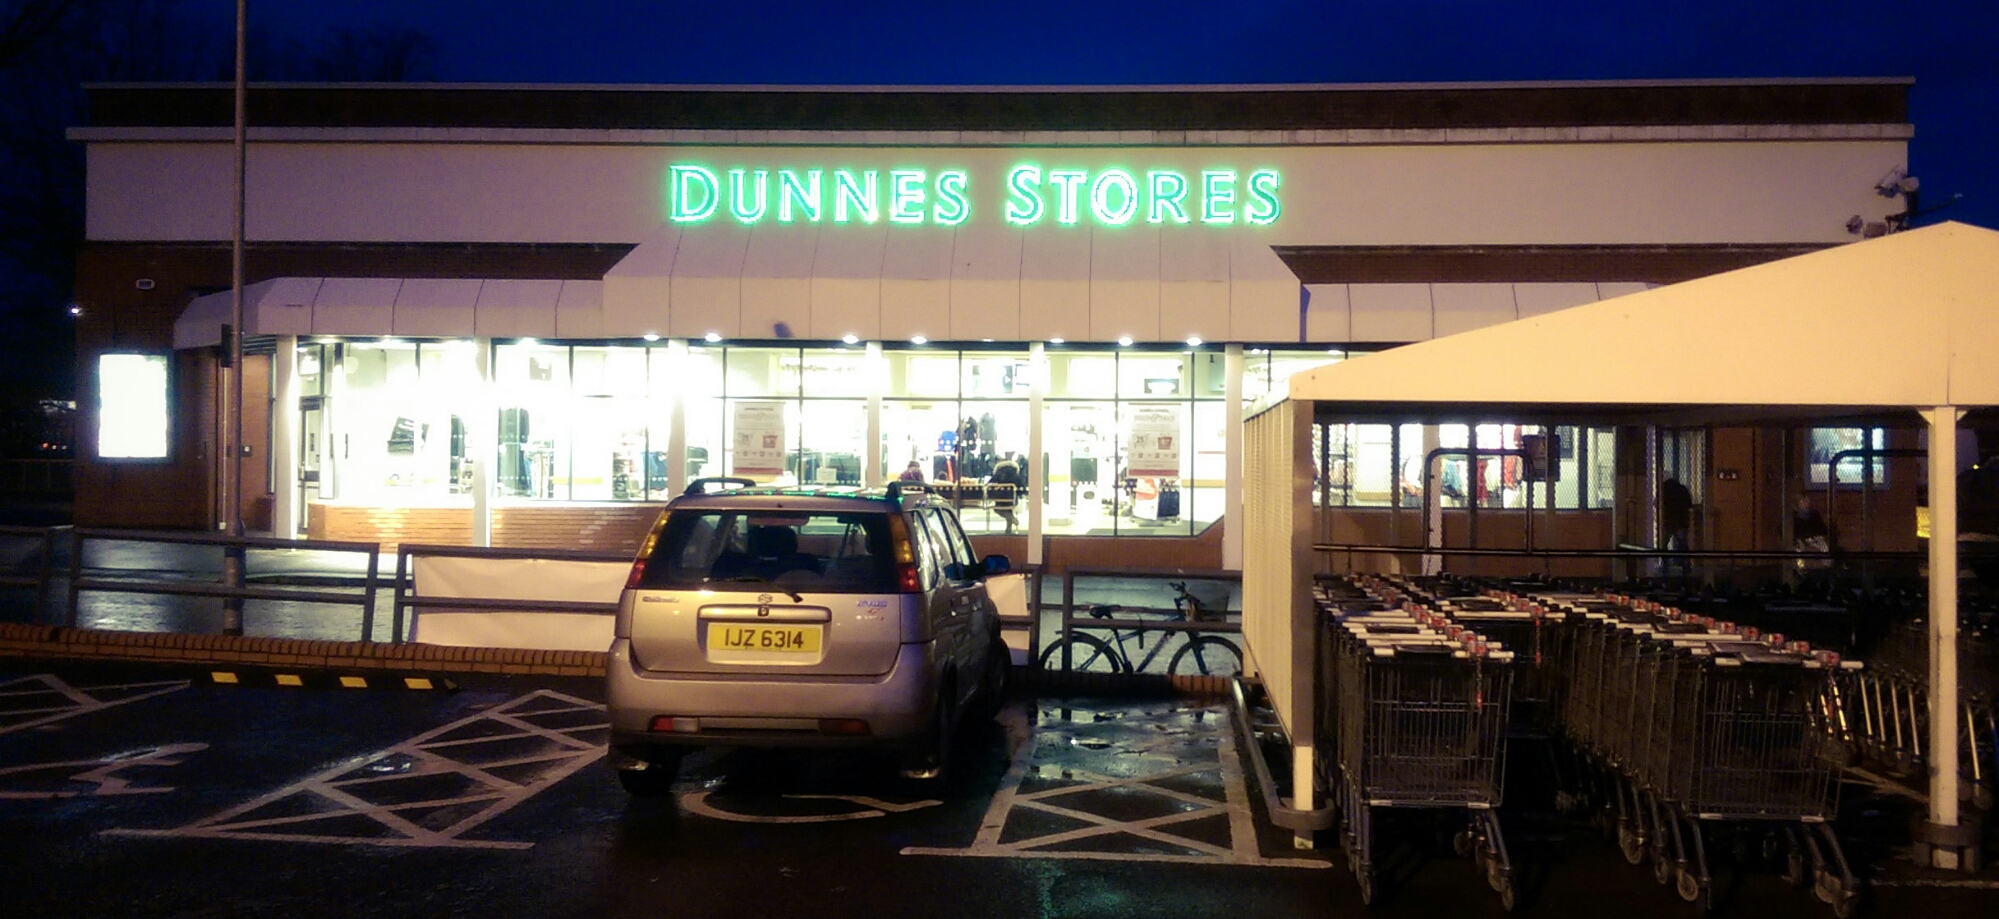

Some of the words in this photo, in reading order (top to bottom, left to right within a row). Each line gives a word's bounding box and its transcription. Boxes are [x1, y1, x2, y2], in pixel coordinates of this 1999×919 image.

[670, 165, 971, 224] DUNNES
[1006, 165, 1281, 224] STORES
[725, 629, 755, 646] IJZ
[761, 630, 804, 648] 6314
